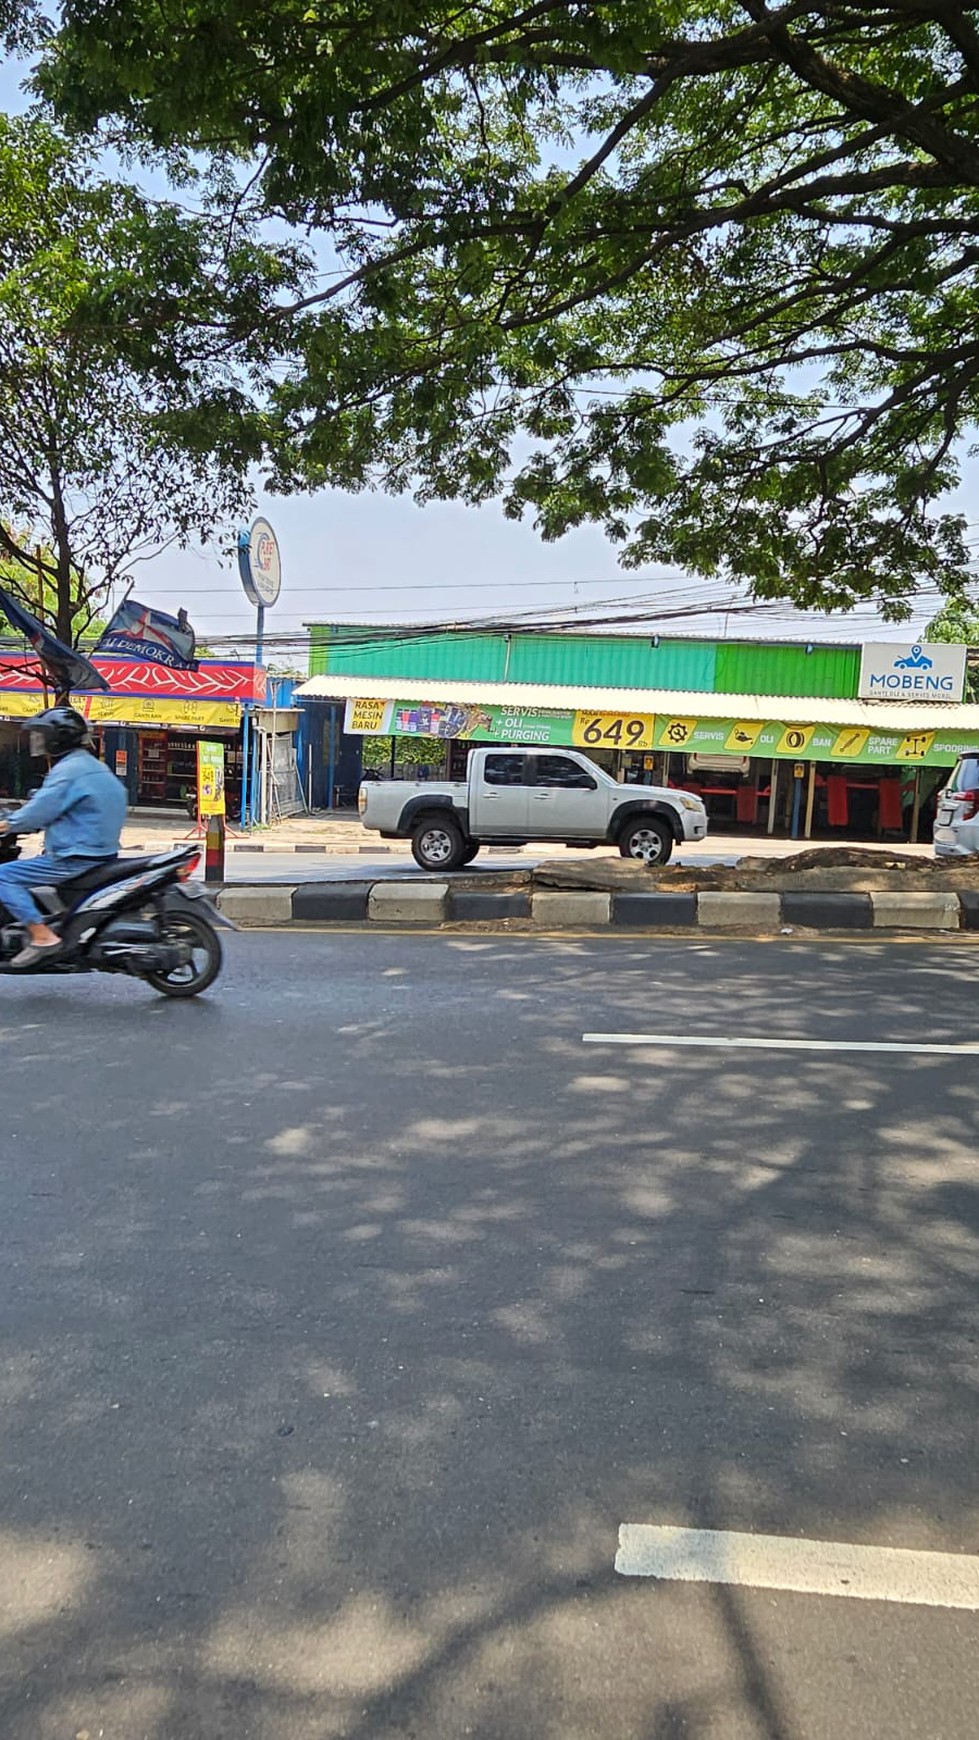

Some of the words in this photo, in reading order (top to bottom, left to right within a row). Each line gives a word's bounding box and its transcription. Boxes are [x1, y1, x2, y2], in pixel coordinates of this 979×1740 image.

[870, 674, 953, 691] MOBENG
[355, 701, 380, 710] RASA
[353, 711, 383, 720] MESIN
[500, 706, 538, 718] SERVIS
[351, 721, 378, 730] BARU
[505, 718, 523, 728] OLI
[501, 730, 550, 742] PURGING
[583, 718, 645, 747] 649
[693, 731, 724, 741] SERVIS
[760, 734, 774, 744] OLI
[812, 738, 832, 747] BAN
[868, 737, 898, 746] SPARE
[868, 746, 892, 755] PART
